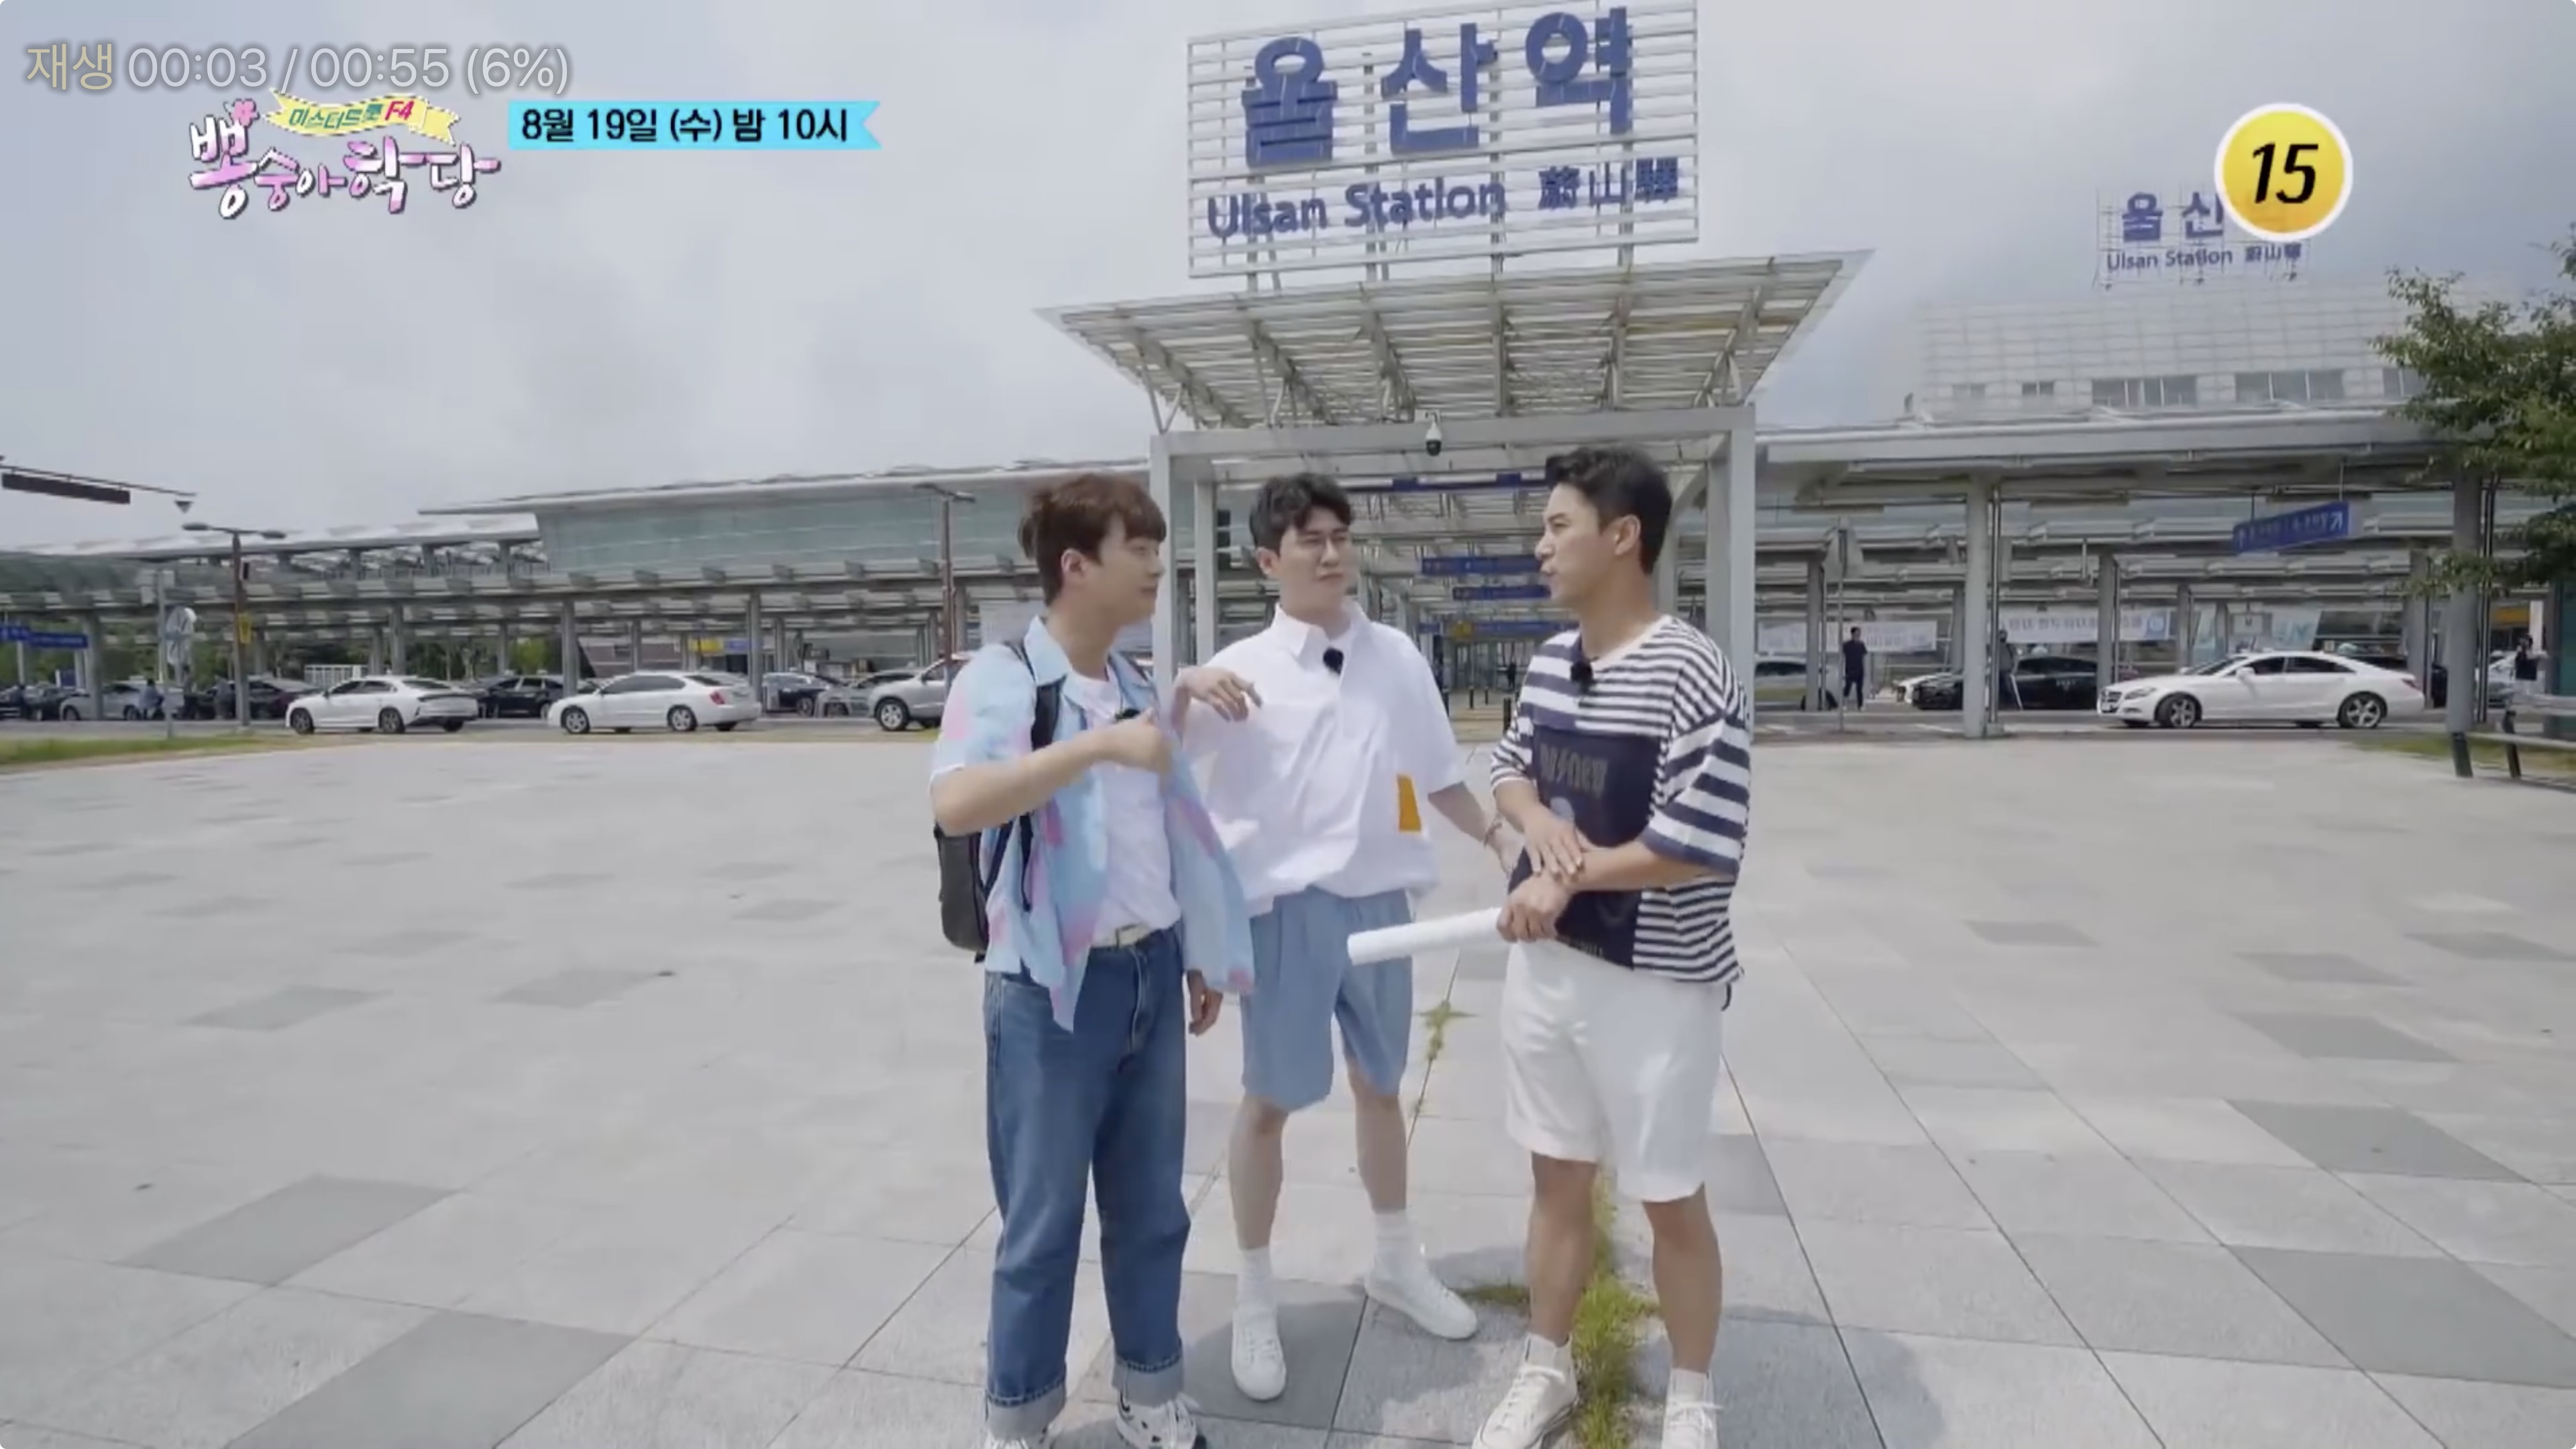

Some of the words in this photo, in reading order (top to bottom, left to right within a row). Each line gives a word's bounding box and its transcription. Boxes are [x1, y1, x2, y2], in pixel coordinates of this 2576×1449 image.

[1241, 7, 1632, 168] 울산역
[1208, 192, 1328, 239] Ulsan
[1344, 176, 1506, 229] Station
[2121, 191, 2224, 242] 울산
[2106, 251, 2159, 271] Ulsan
[2165, 248, 2233, 268] Station
